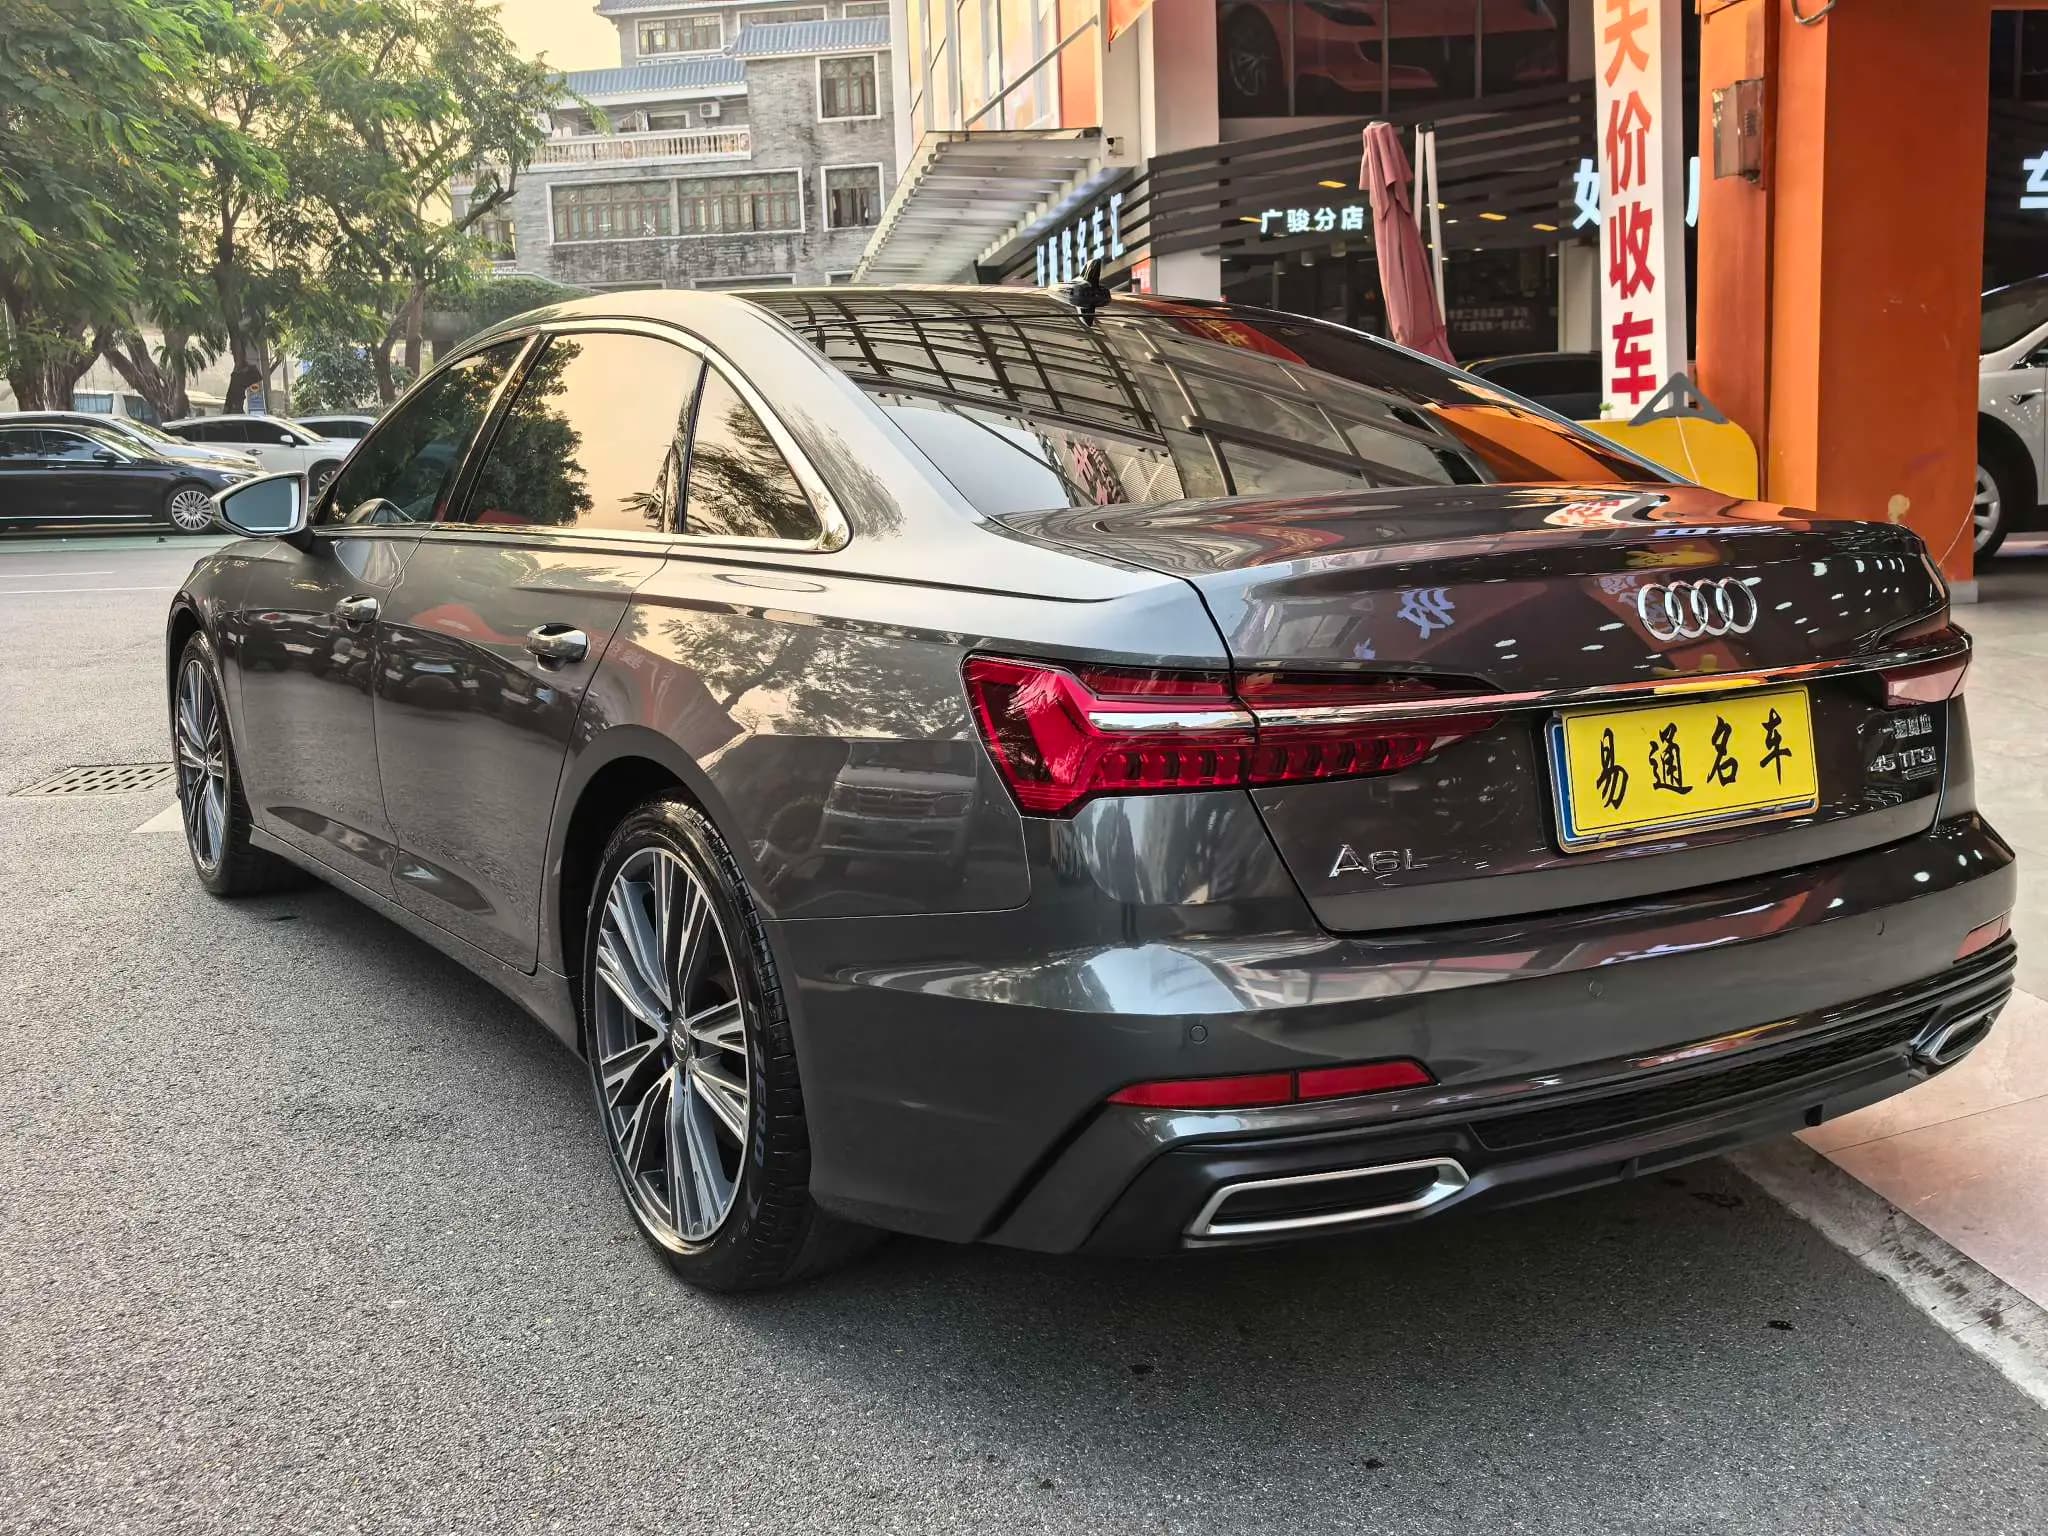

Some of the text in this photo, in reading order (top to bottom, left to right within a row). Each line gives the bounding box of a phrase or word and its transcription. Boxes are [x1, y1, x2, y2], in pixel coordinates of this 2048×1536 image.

[1260, 205, 1364, 234] 广骏分店
[1596, 707, 1793, 810] 易通名车
[1868, 752, 1897, 773] 45
[1898, 746, 1938, 769] TFSI
[1328, 843, 1429, 878] A6L
[754, 1040, 767, 1168] ZERO
